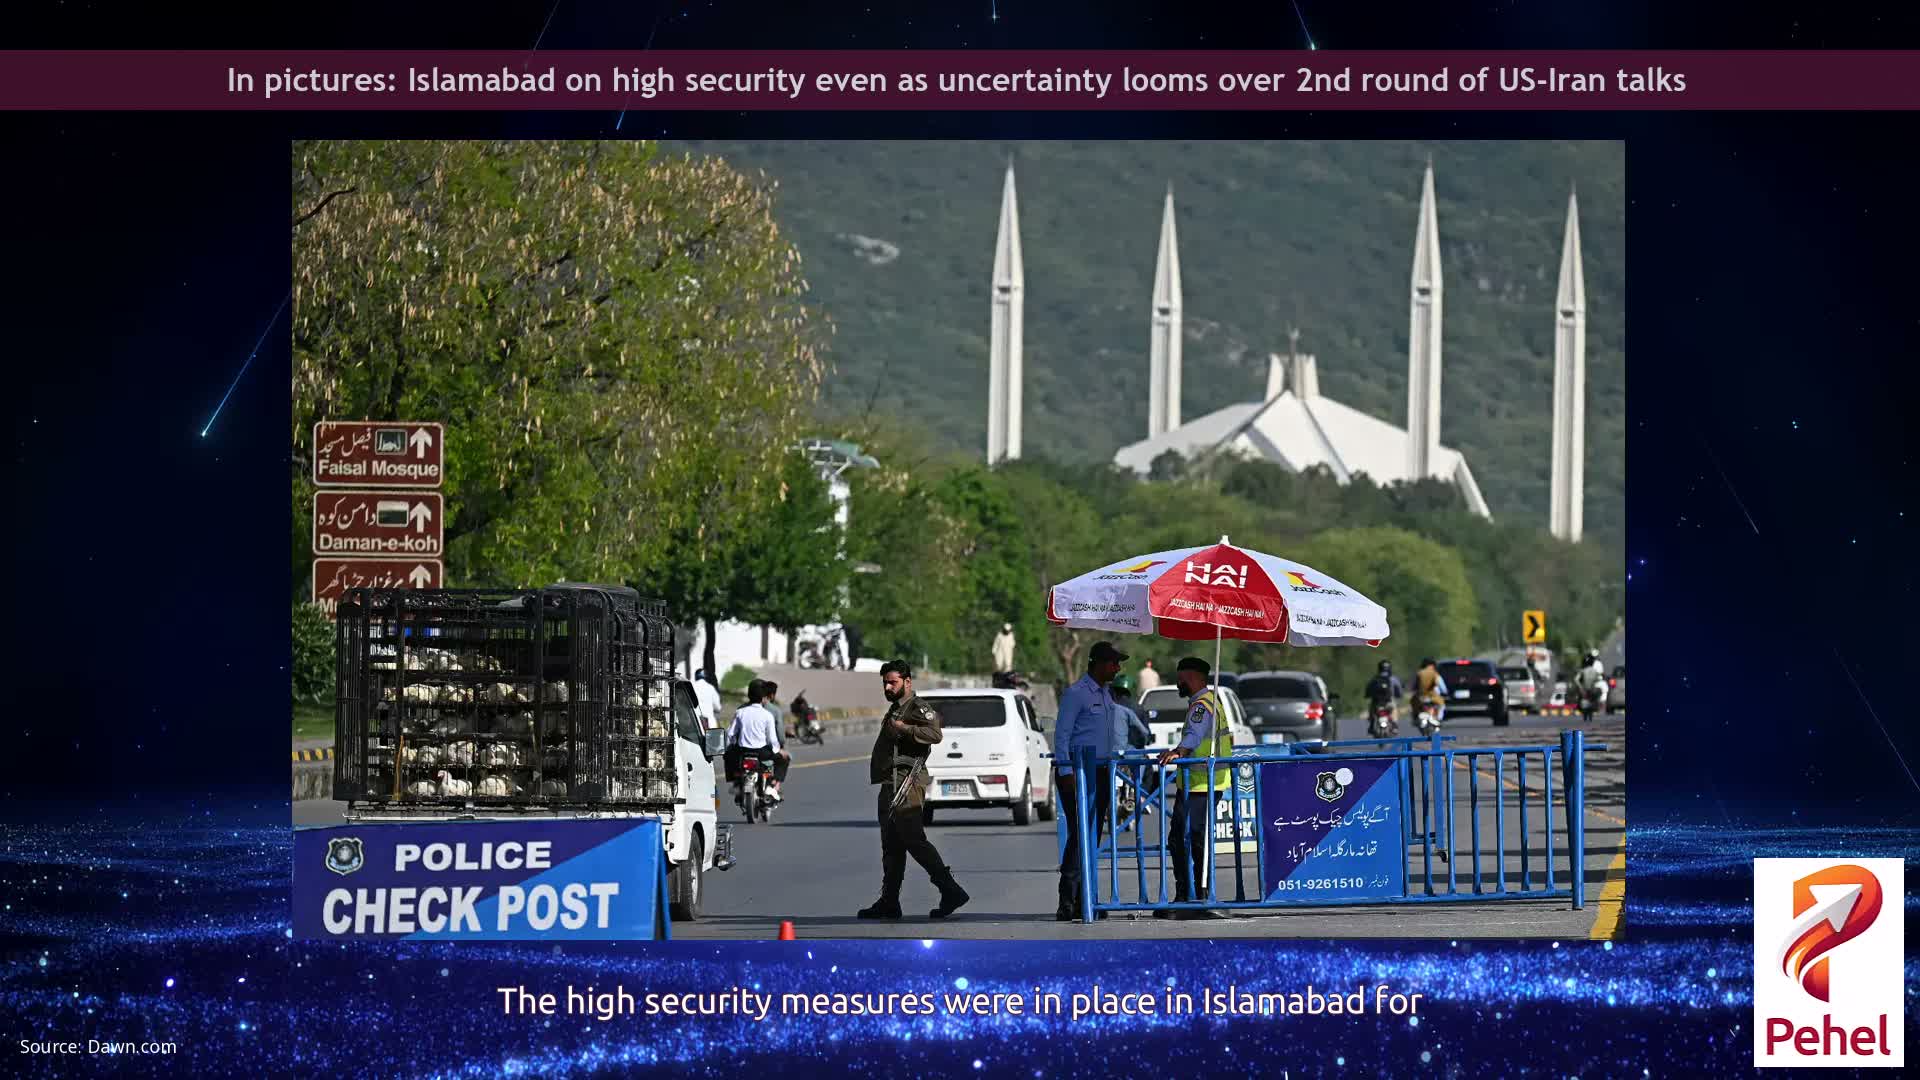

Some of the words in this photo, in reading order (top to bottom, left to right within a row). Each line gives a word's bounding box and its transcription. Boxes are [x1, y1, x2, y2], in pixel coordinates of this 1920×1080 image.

[319, 435, 345, 459] مسجد
[341, 427, 371, 457] فیصل
[318, 459, 367, 476] Faisal
[371, 460, 439, 480] Mosque
[337, 502, 376, 531] دامن
[319, 534, 437, 551] Daman-e-koh
[1187, 561, 1248, 577] HAI
[1185, 572, 1247, 589] NA!
[1273, 816, 1291, 832] ہے
[1290, 812, 1319, 831] پوسٹ
[1318, 807, 1343, 828] چیک
[1343, 802, 1371, 829] پولیس
[1368, 804, 1391, 823] آگے
[1213, 821, 1253, 839] HEK
[395, 841, 552, 872] POLICE
[1286, 841, 1308, 863] آباد
[1303, 844, 1332, 865] اسلام
[1278, 877, 1364, 891] 051-9261510
[322, 886, 484, 934] CHECK
[497, 882, 620, 931] POST
